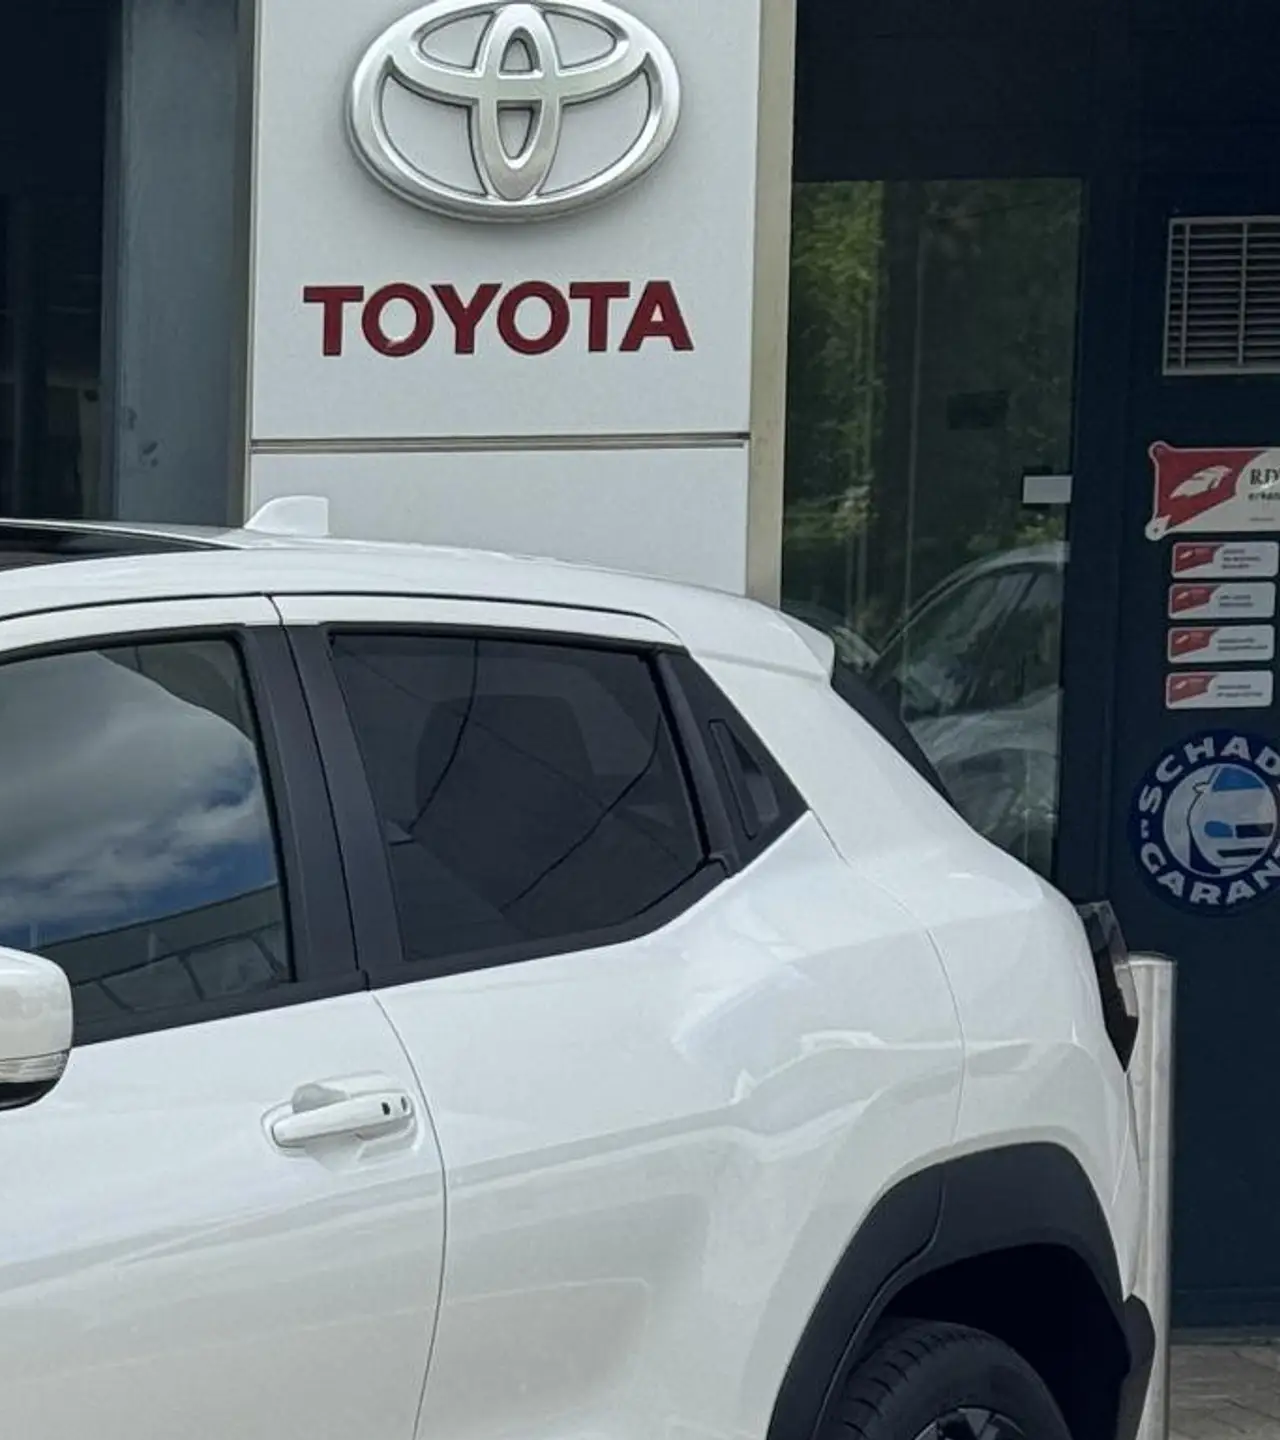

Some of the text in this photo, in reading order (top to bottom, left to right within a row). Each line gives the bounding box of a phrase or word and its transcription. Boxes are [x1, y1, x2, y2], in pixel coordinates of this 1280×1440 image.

[303, 280, 694, 357] TOYOTA
[1250, 468, 1280, 486] RD
[1138, 736, 1280, 815] SCHAD
